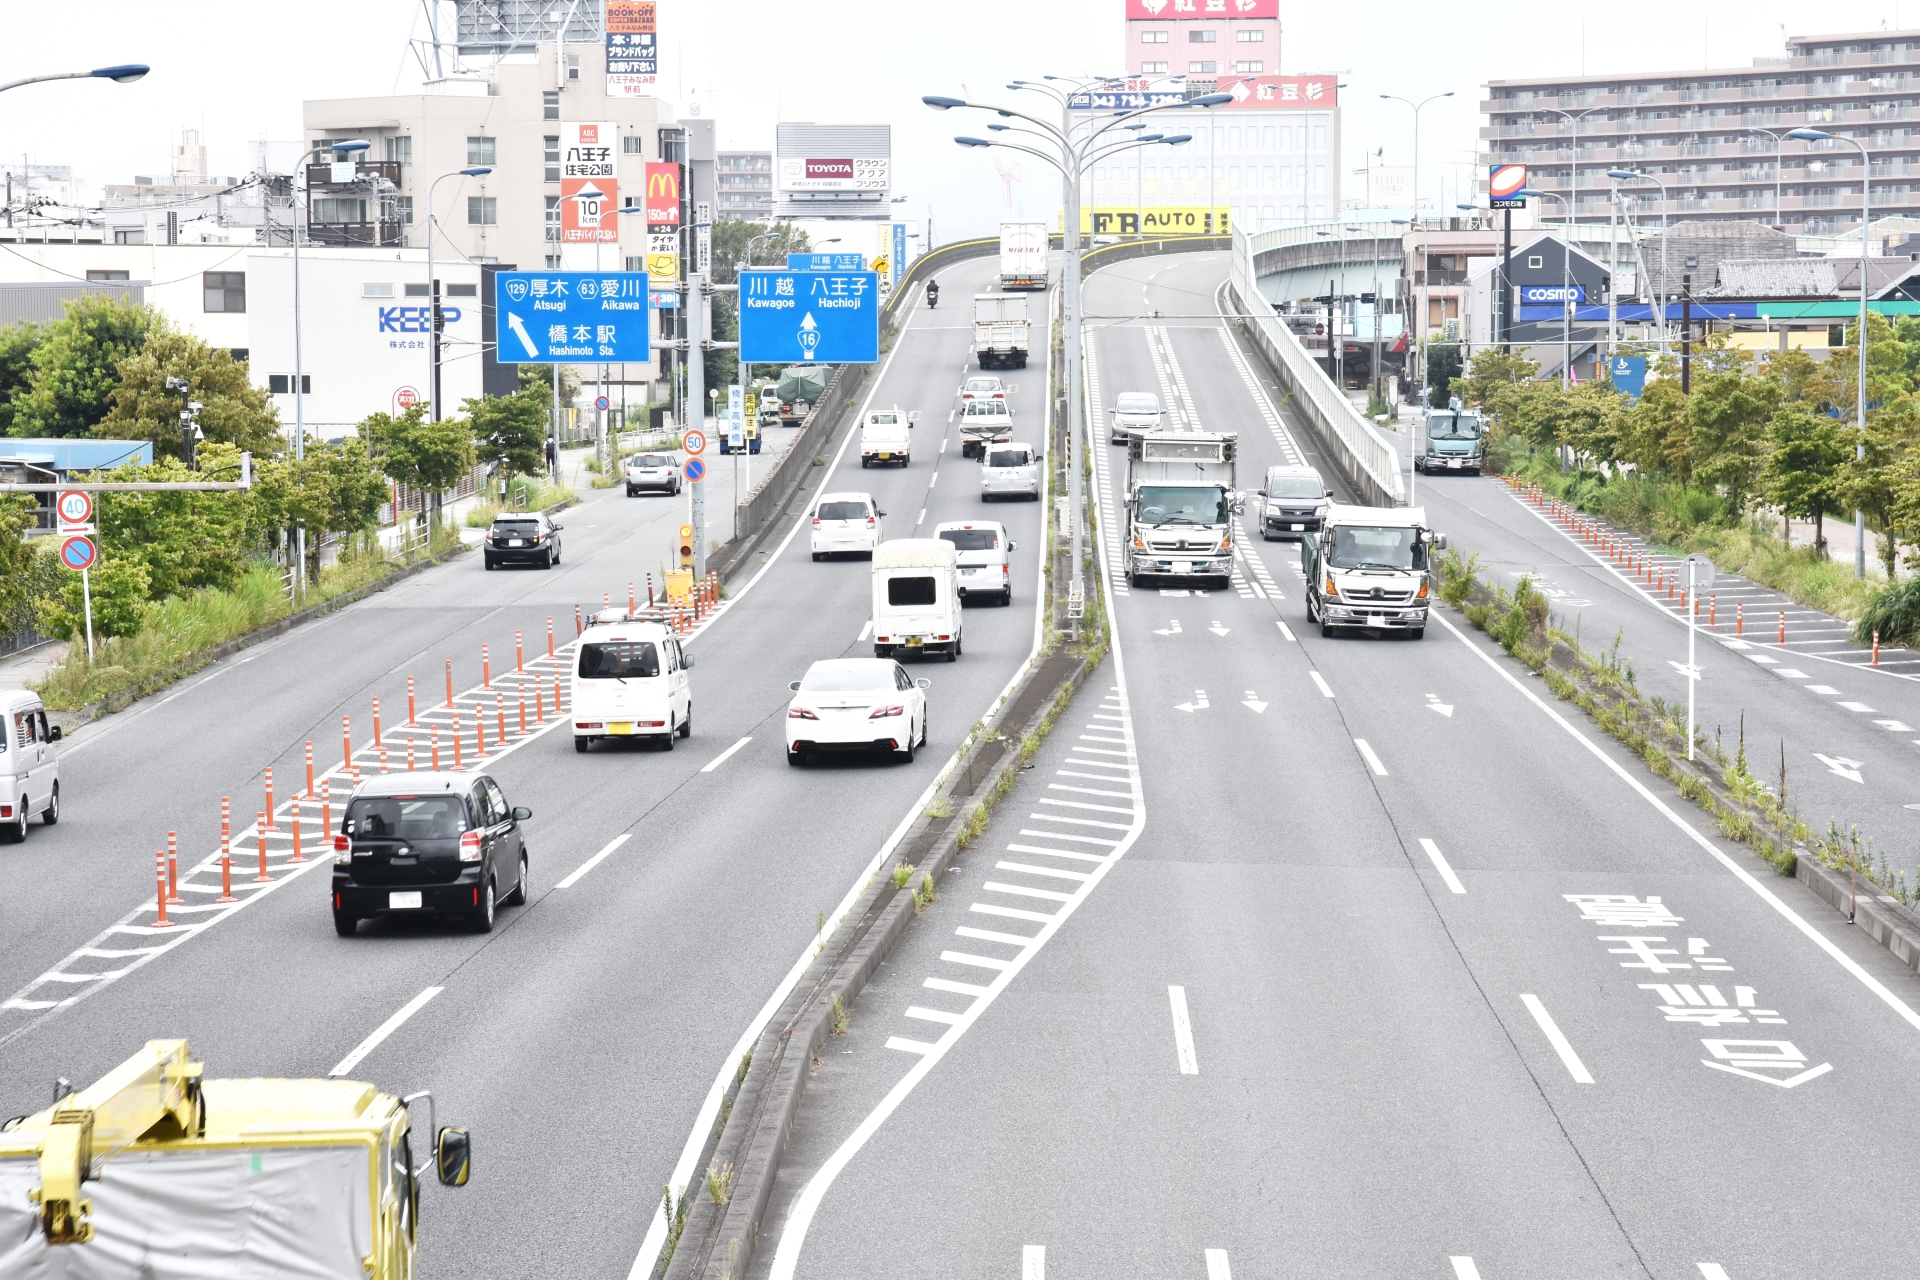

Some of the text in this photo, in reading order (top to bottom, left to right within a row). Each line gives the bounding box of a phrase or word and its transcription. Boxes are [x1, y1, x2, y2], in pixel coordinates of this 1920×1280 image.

[611, 34, 652, 45] 本・洋服
[608, 46, 655, 57] ブランドバッグ
[609, 62, 655, 72] お売り下さい
[608, 76, 656, 84] 八王子みなみ野
[624, 85, 641, 94] 駅前
[1256, 83, 1323, 100] 紅豆杉
[566, 147, 611, 162] 八王子
[565, 164, 612, 176] 住宅公園
[807, 164, 852, 172] TOYOTA
[858, 170, 885, 178] アクア
[856, 180, 886, 188] プリウス
[581, 200, 598, 216] 10
[1494, 200, 1523, 208] コスモ石油
[582, 216, 598, 224] km
[647, 209, 668, 220] 150m
[1144, 213, 1196, 226] AUTO
[564, 230, 616, 240] 八王子バイパス沿い
[652, 236, 674, 244] タイヤ
[811, 256, 860, 264] 川越 八王子
[508, 284, 525, 294] 129
[530, 279, 569, 298] 厚木
[581, 284, 595, 294] 63
[600, 279, 640, 298] 愛川
[750, 276, 868, 296] 川越 八王子
[1528, 288, 1578, 300] COSMO
[534, 300, 640, 312] Atsugi Aikawa
[748, 298, 860, 310] Kawagoe Hachioji
[378, 306, 462, 332] KEEP
[548, 324, 616, 344] 橋本駅
[802, 333, 816, 346] 16
[389, 340, 425, 348] 株式会社
[549, 346, 616, 356] Hashimoto Sta.
[746, 396, 754, 414] 走行
[732, 389, 740, 442] 橋本高架橋
[746, 418, 754, 438] 注意
[688, 436, 702, 448] 50
[65, 498, 85, 514] 40
[1562, 894, 1834, 1088] 合流注意
